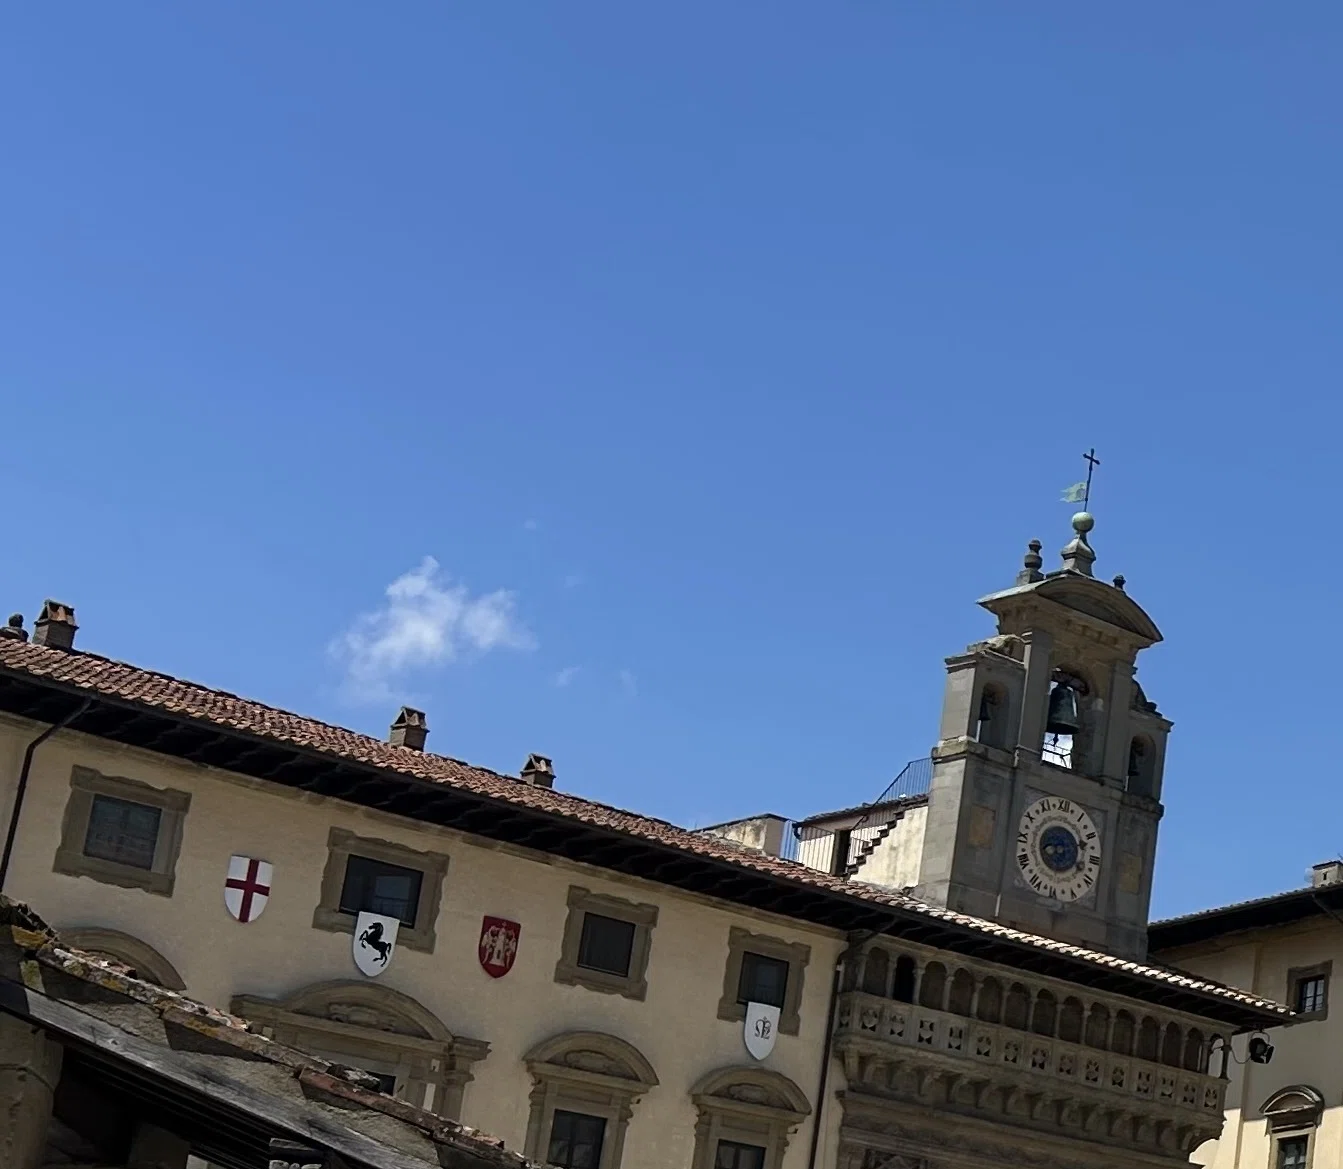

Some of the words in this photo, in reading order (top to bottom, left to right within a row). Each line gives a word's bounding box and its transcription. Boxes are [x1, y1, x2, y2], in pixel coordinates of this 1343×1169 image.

[1039, 799, 1051, 813] XI
[1058, 799, 1070, 813] XII
[1024, 812, 1035, 823] X
[1077, 813, 1085, 822] I
[1017, 832, 1029, 843] IX
[1086, 832, 1097, 841] II
[1089, 855, 1100, 866] III
[1029, 873, 1043, 891] VII
[1070, 887, 1078, 899] V
